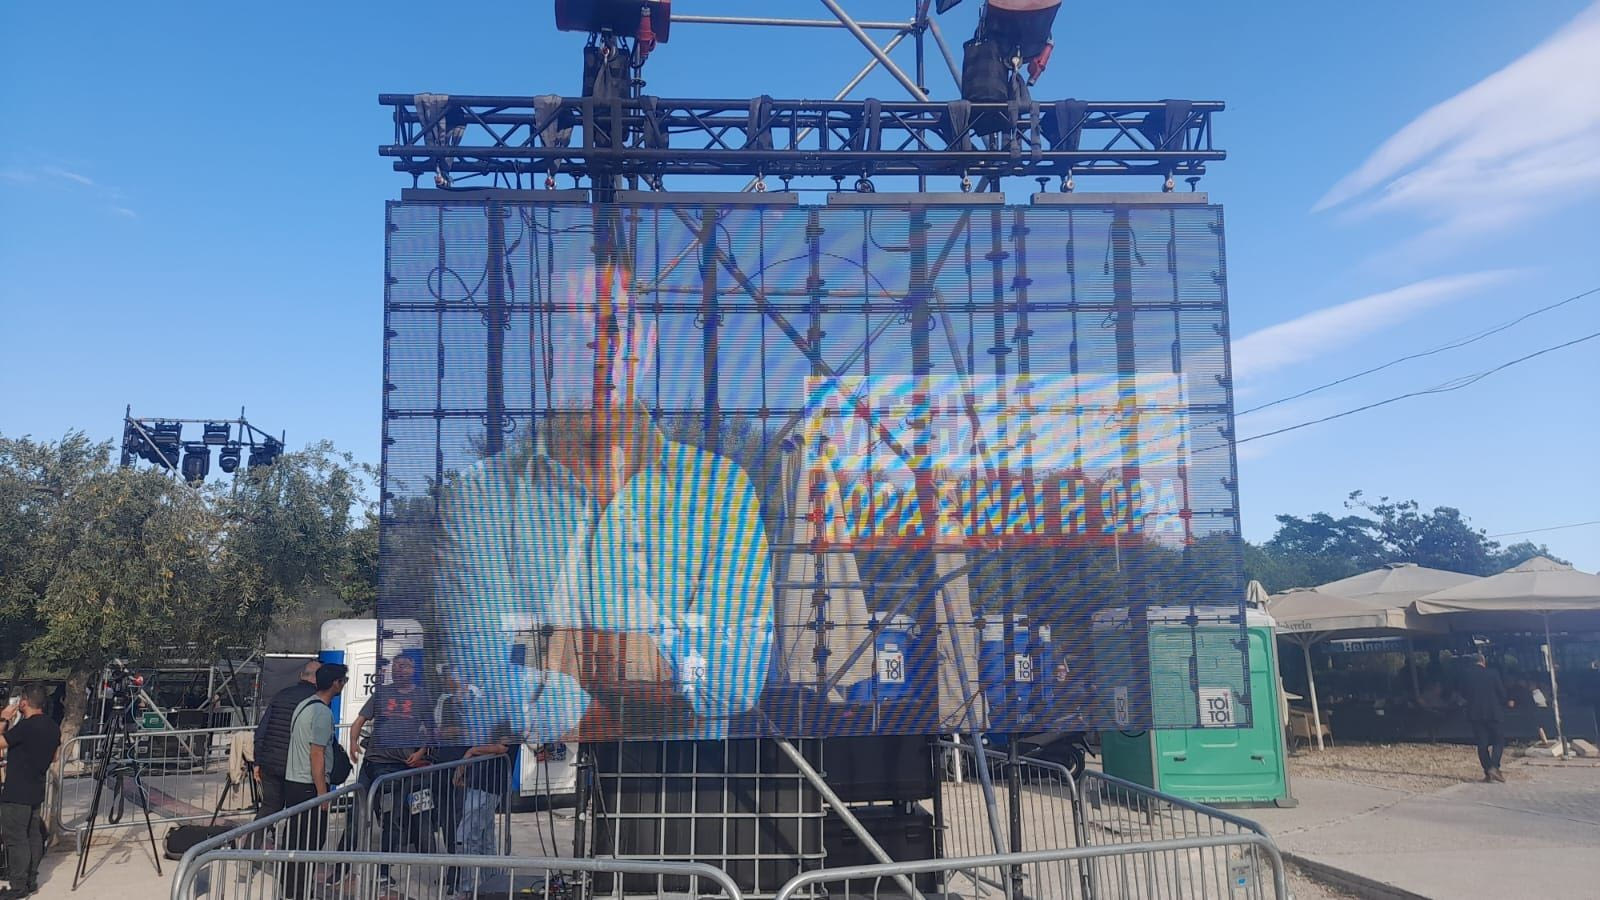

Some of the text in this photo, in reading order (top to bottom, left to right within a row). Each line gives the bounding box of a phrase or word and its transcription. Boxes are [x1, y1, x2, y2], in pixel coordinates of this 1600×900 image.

[935, 479, 1045, 536] ΕΙΝΑΙ
[1059, 479, 1087, 534] Η
[1101, 478, 1187, 534] ΩΡΑ
[885, 658, 901, 669] TOI
[1019, 660, 1031, 670] TO
[690, 666, 705, 678] TO
[886, 669, 901, 680] TOI
[1206, 698, 1229, 710] TOI
[1208, 710, 1230, 722] TOI
